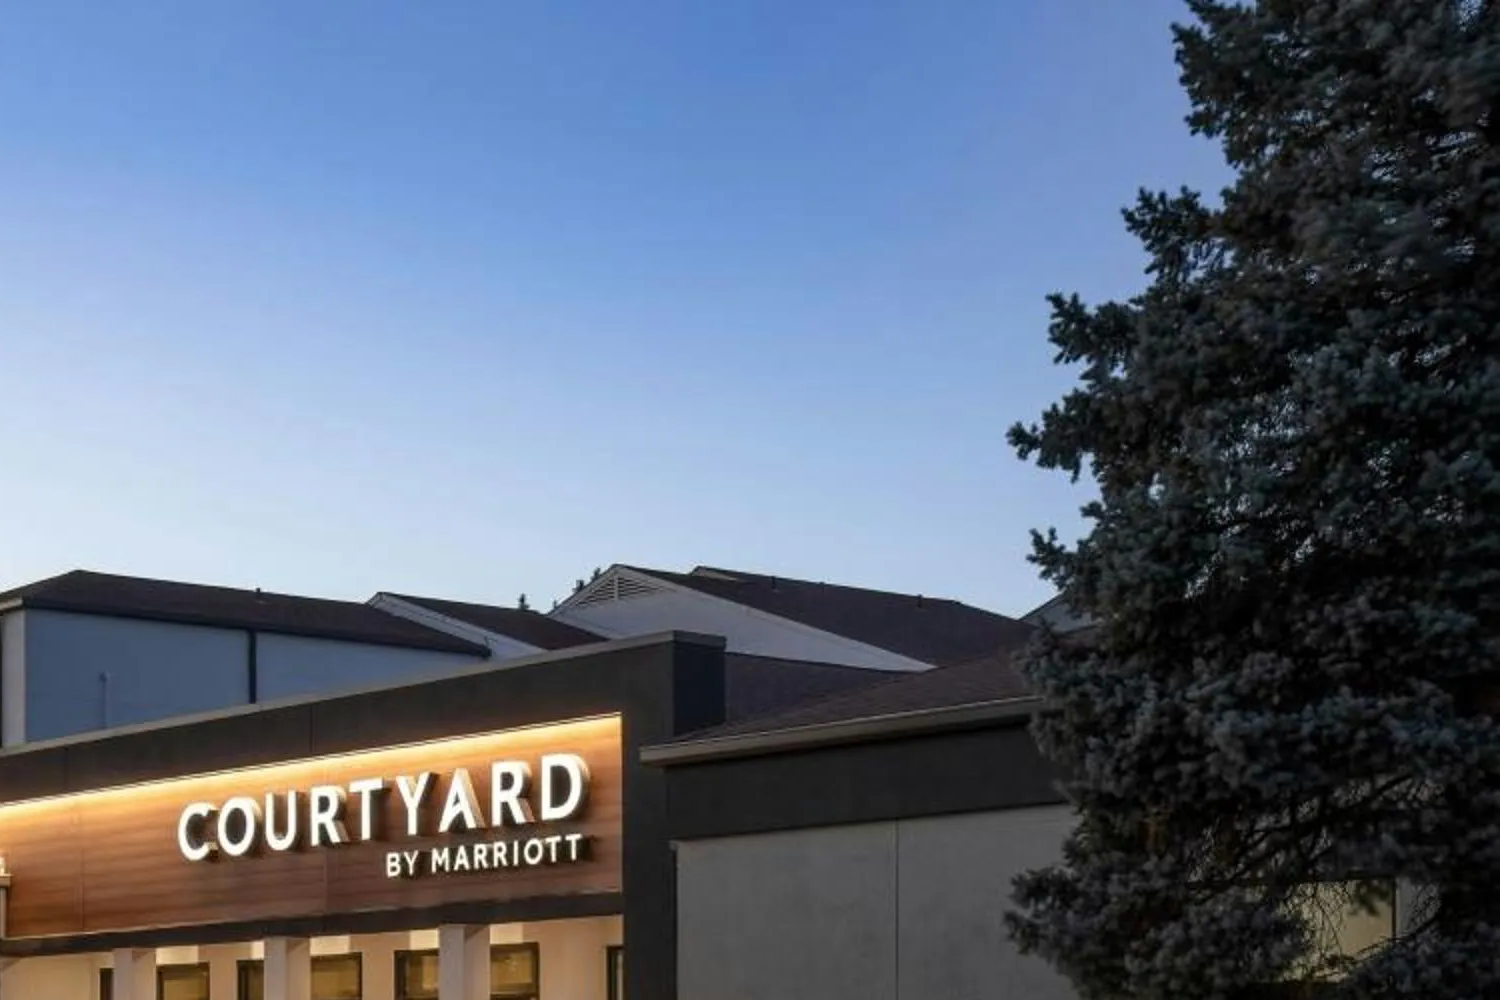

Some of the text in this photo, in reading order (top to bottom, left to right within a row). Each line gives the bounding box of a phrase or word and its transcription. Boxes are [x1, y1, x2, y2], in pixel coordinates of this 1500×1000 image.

[177, 753, 588, 861] COURTYARD
[386, 833, 583, 878] BY MARRIOTT
